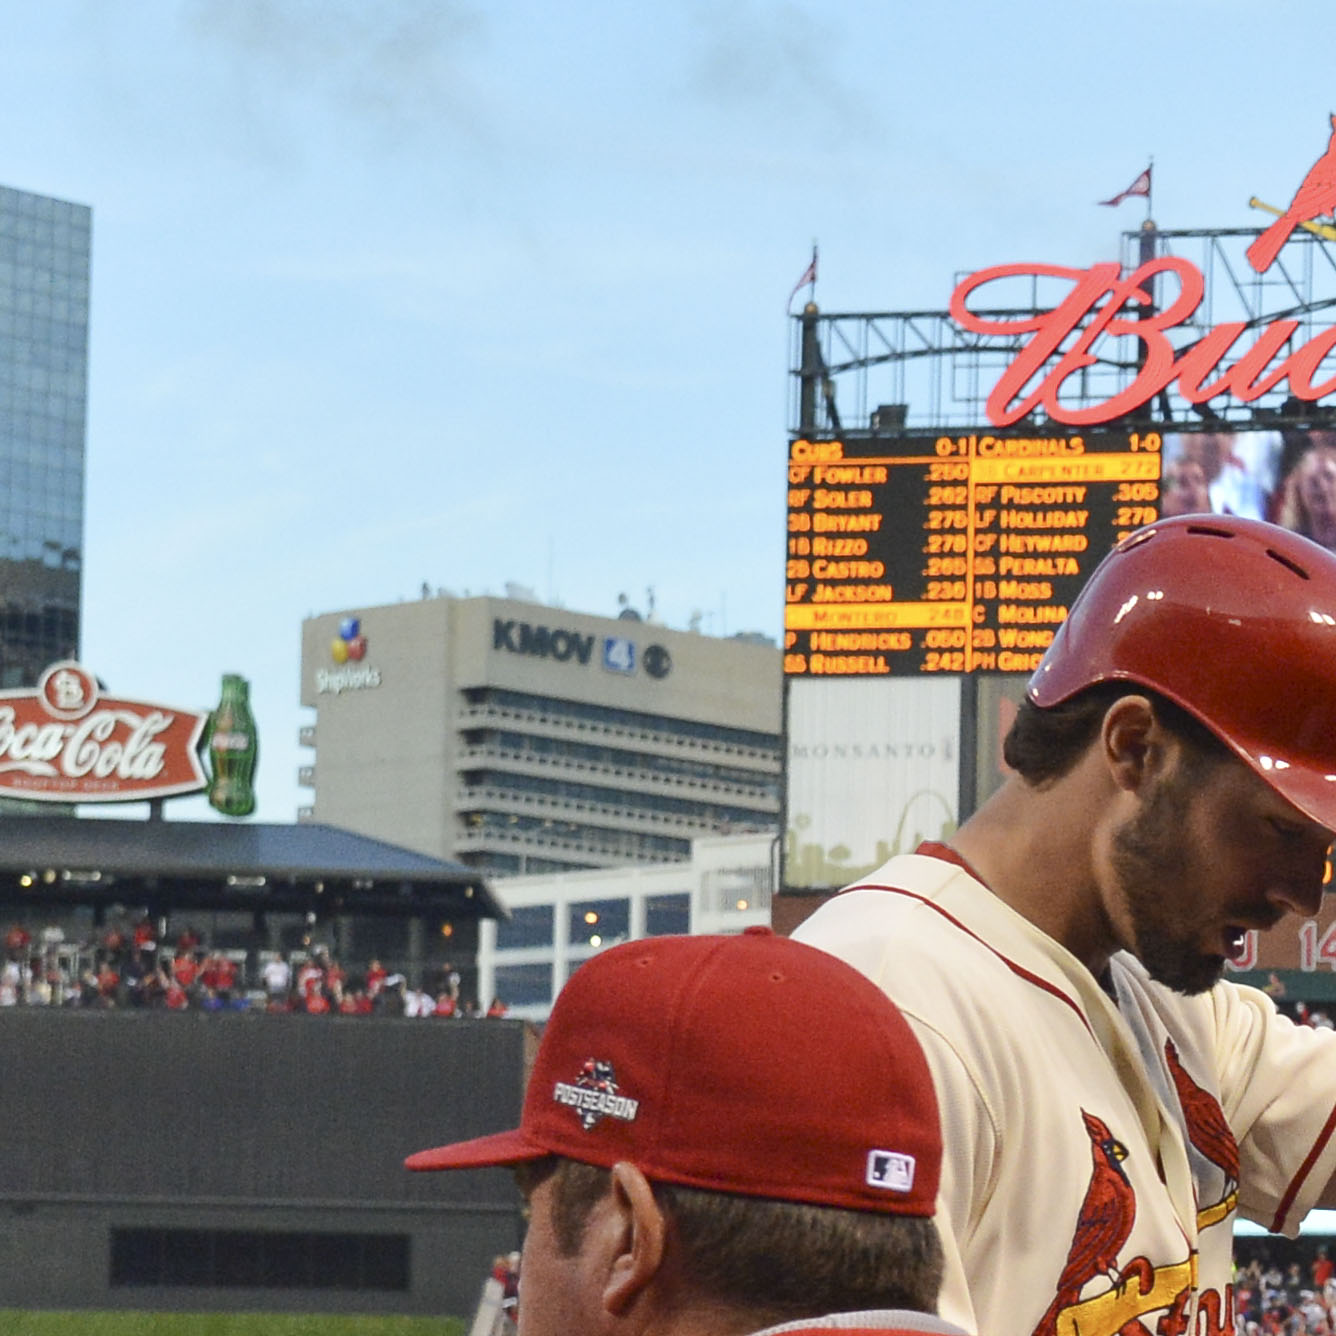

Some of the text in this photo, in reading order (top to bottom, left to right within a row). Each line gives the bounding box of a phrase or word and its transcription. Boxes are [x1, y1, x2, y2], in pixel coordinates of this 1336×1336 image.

[1129, 432, 1161, 452] 1-0
[972, 604, 987, 623] C
[493, 618, 595, 665] KMOV
[790, 743, 936, 760] MONSANTO
[553, 1081, 640, 1122] POSTSEASON
